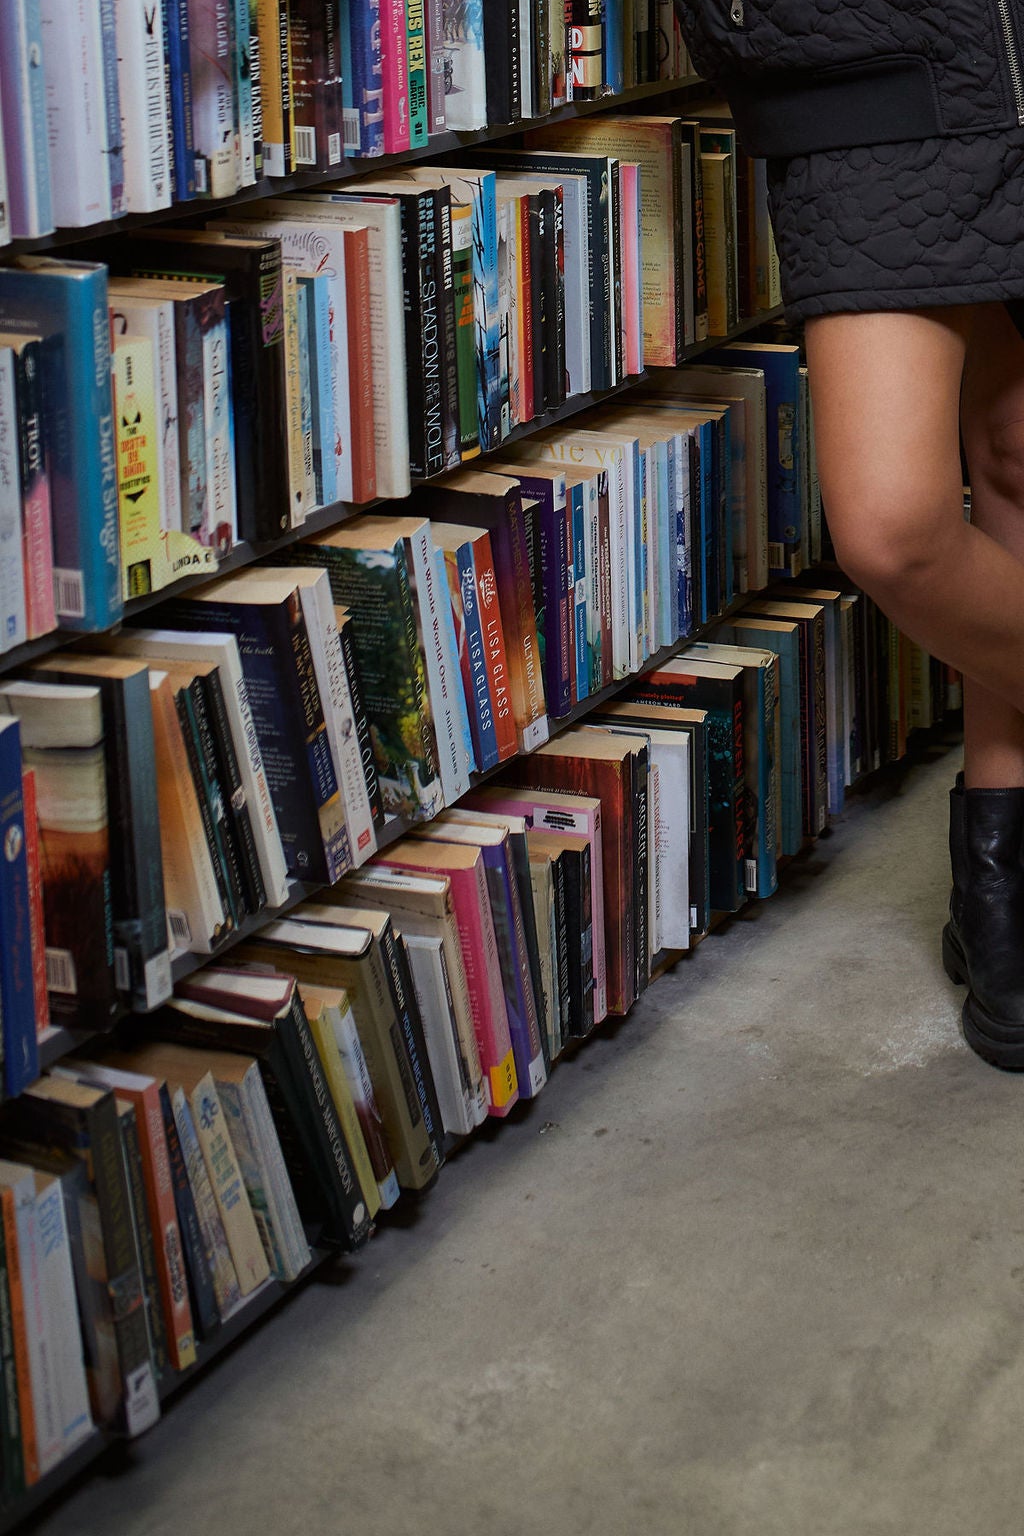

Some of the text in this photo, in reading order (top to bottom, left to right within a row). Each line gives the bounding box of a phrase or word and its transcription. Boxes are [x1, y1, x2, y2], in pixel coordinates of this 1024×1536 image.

[179, 2, 188, 41] BLUES
[216, 3, 227, 58] JAGUAR
[279, 11, 289, 111] MENDING SKINS
[408, 36, 424, 73] REX
[145, 40, 164, 183] FATE THE HUNTER
[249, 35, 263, 143] ALTON GANSKY
[409, 80, 418, 118] GARCIA
[417, 85, 425, 108] ERIC
[418, 198, 428, 259] GHELFI
[425, 197, 436, 253] BRENT
[441, 205, 453, 290] BRENT GHELFI
[696, 241, 705, 298] GAME
[210, 338, 223, 418] Solace
[361, 295, 370, 383] YOUNG LITERARY
[422, 280, 443, 468] SHADOW WOLF
[445, 303, 458, 413] VOLK'S GAME
[26, 412, 40, 472] TROY
[101, 414, 117, 566] Dark Singer
[172, 554, 200, 573] LINDA
[461, 568, 475, 617] Blue
[479, 568, 494, 610] Ride
[421, 535, 449, 700] The Whole World Over
[291, 633, 315, 728] IN MY HAND
[300, 635, 320, 713] THE WORDS
[469, 631, 492, 732] LISA GLASS
[487, 619, 510, 719] LISA GLASS
[523, 635, 539, 719] ULTIMATUM
[355, 716, 379, 800] BLOOD
[445, 709, 454, 741] Julia
[732, 699, 745, 861] ELEVEN LIARS
[384, 933, 406, 1009] NEIL GORDON
[638, 905, 646, 965] GORTNER
[298, 1029, 326, 1106] AND ANGELS
[401, 1012, 434, 1135] YOU'RE BIG GIRL NOW
[322, 1106, 352, 1196] MARY GORDON
